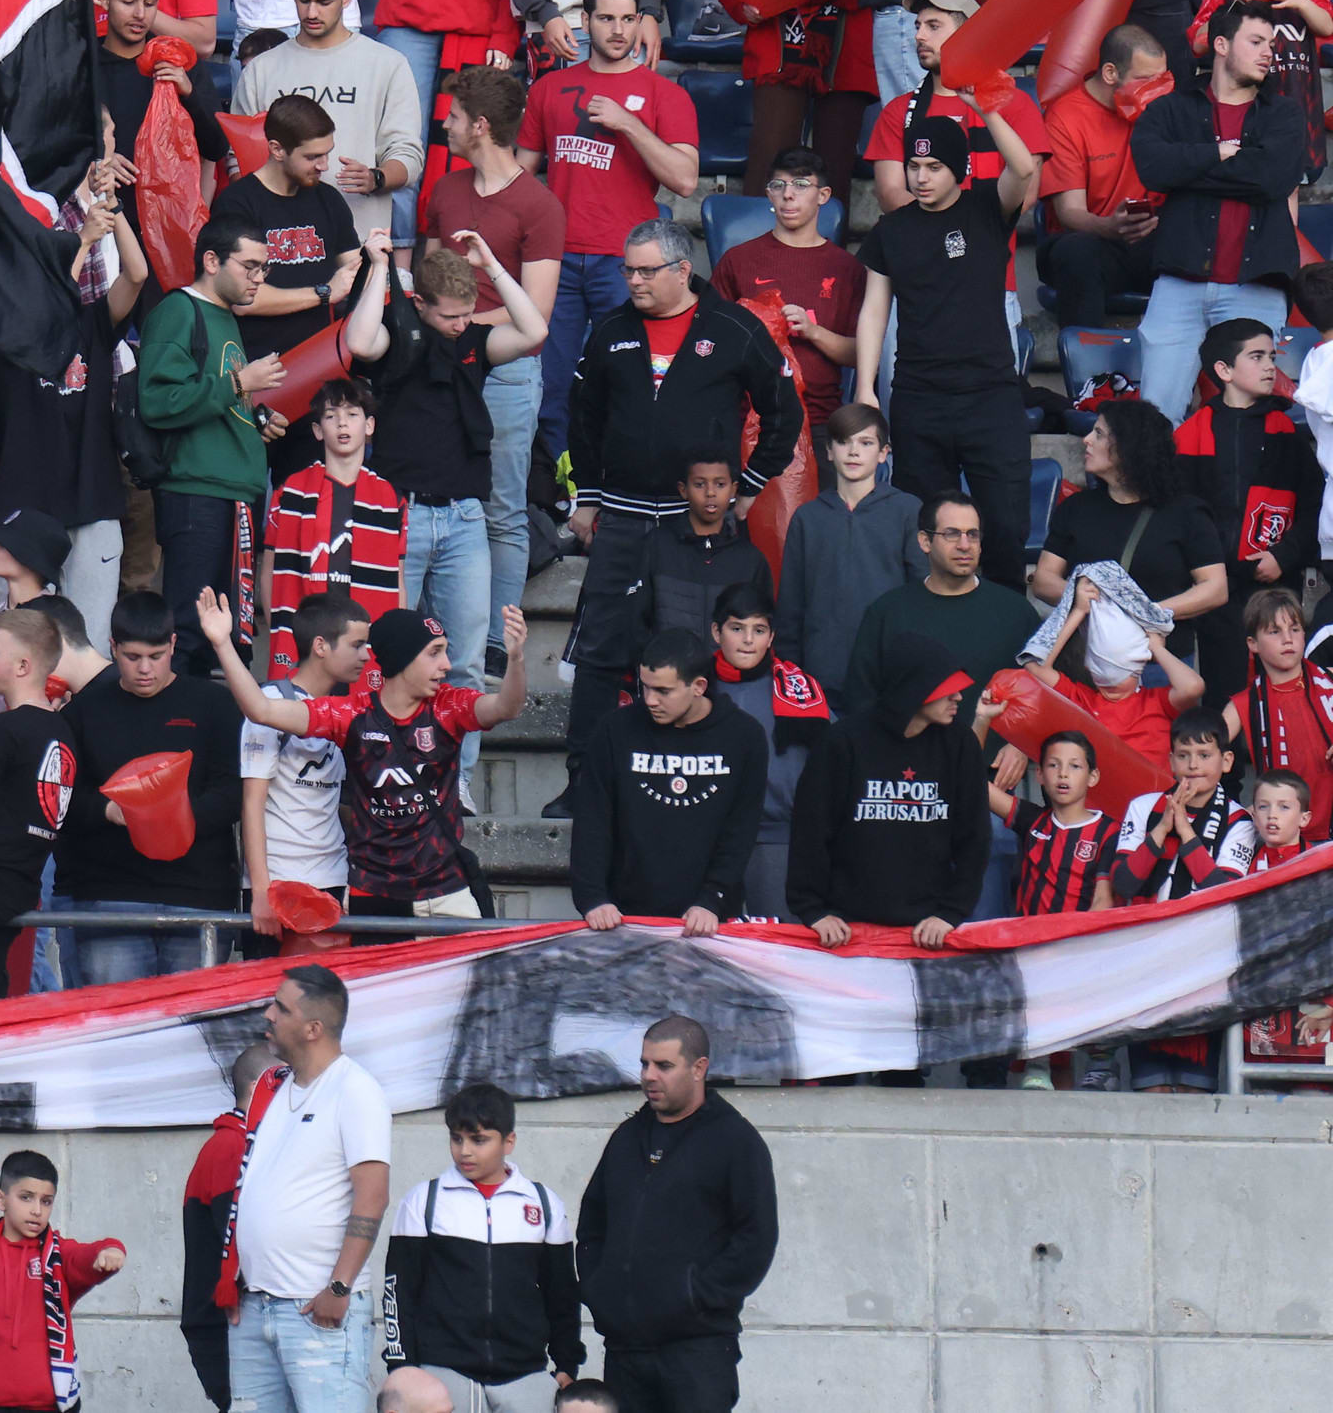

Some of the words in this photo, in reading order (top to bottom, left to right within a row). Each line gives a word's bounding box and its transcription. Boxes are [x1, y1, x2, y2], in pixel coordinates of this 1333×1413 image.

[609, 340, 642, 353] LEGEA
[630, 751, 731, 777] HAPOEL
[638, 781, 721, 808] JERUSALEM
[853, 802, 950, 824] JERUSALM
